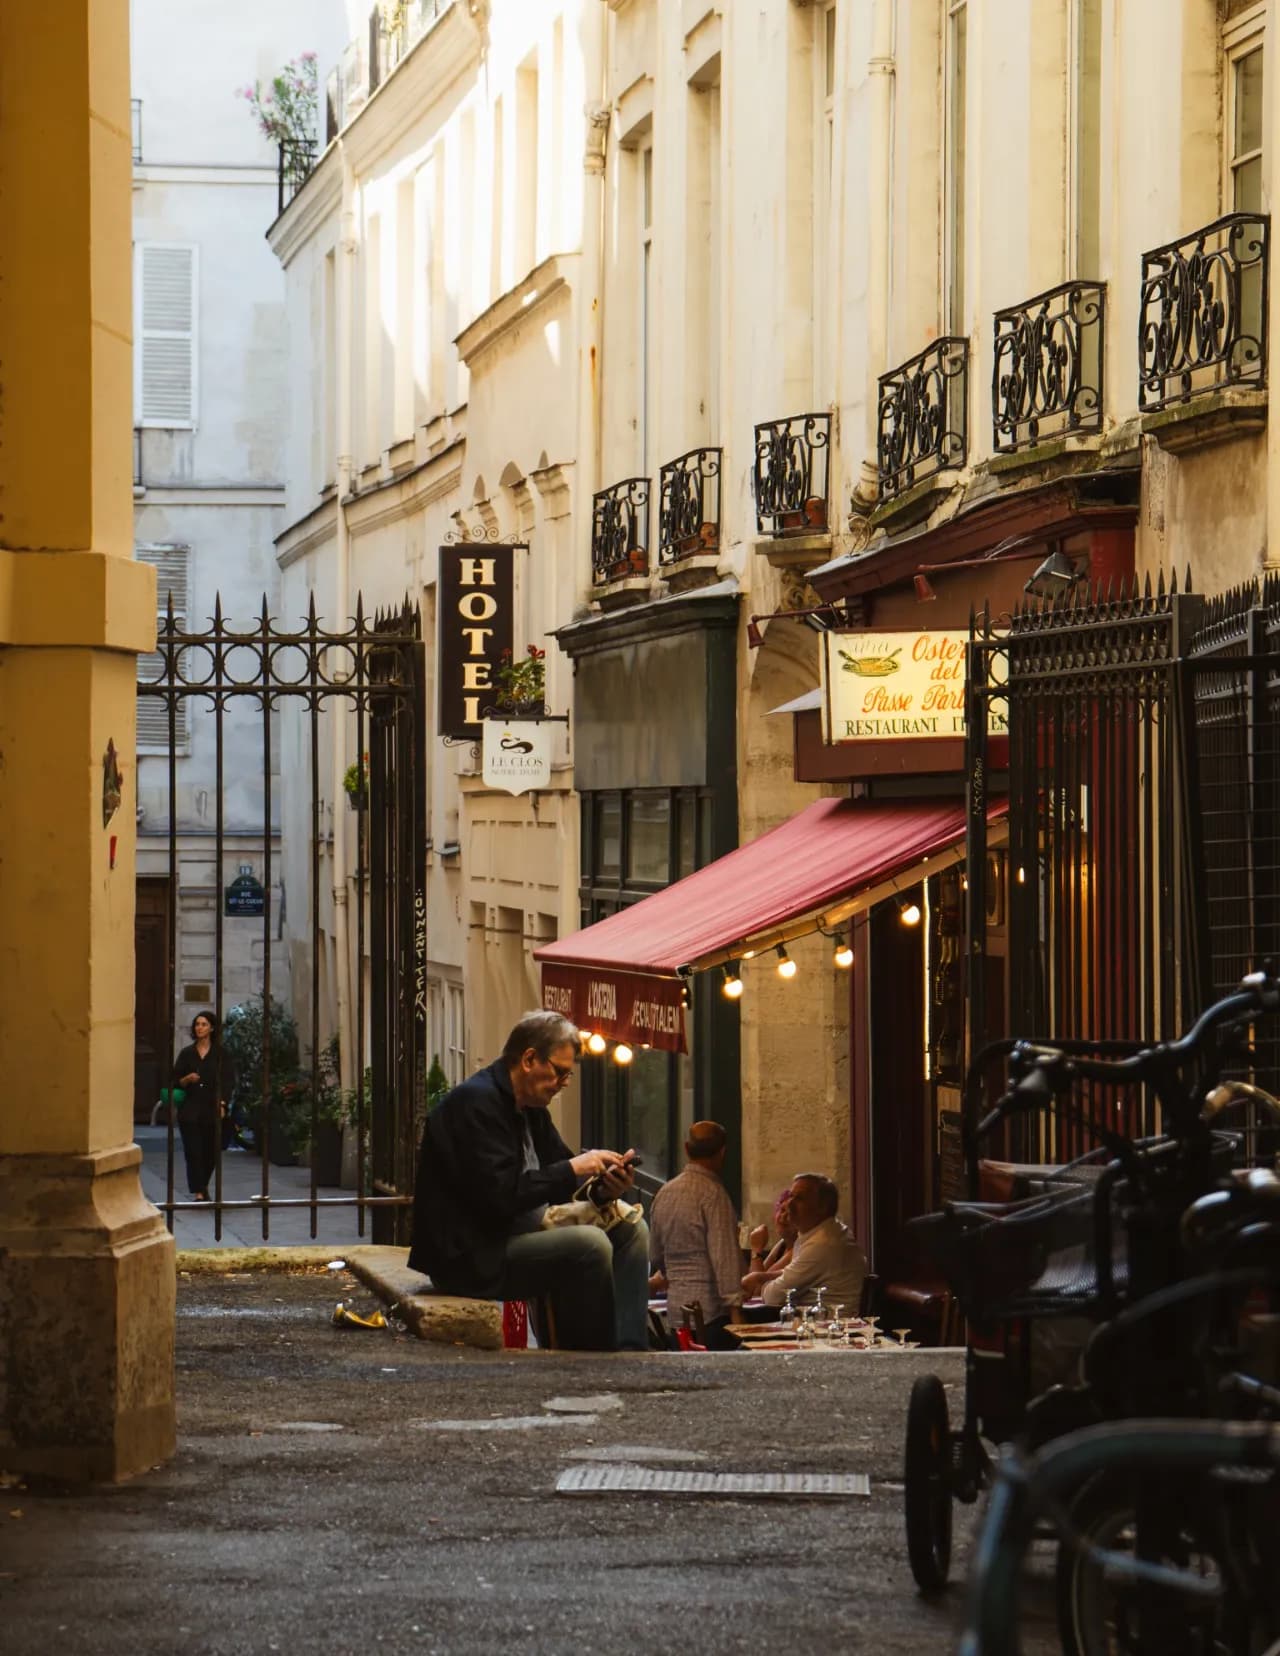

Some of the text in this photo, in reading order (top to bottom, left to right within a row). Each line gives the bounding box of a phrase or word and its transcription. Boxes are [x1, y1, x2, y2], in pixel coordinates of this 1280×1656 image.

[458, 558, 498, 724] HOTEL
[911, 635, 967, 662] Oster
[862, 684, 966, 713] Passe Part
[846, 717, 938, 737] RESTAURANT
[510, 756, 544, 768] CLOS
